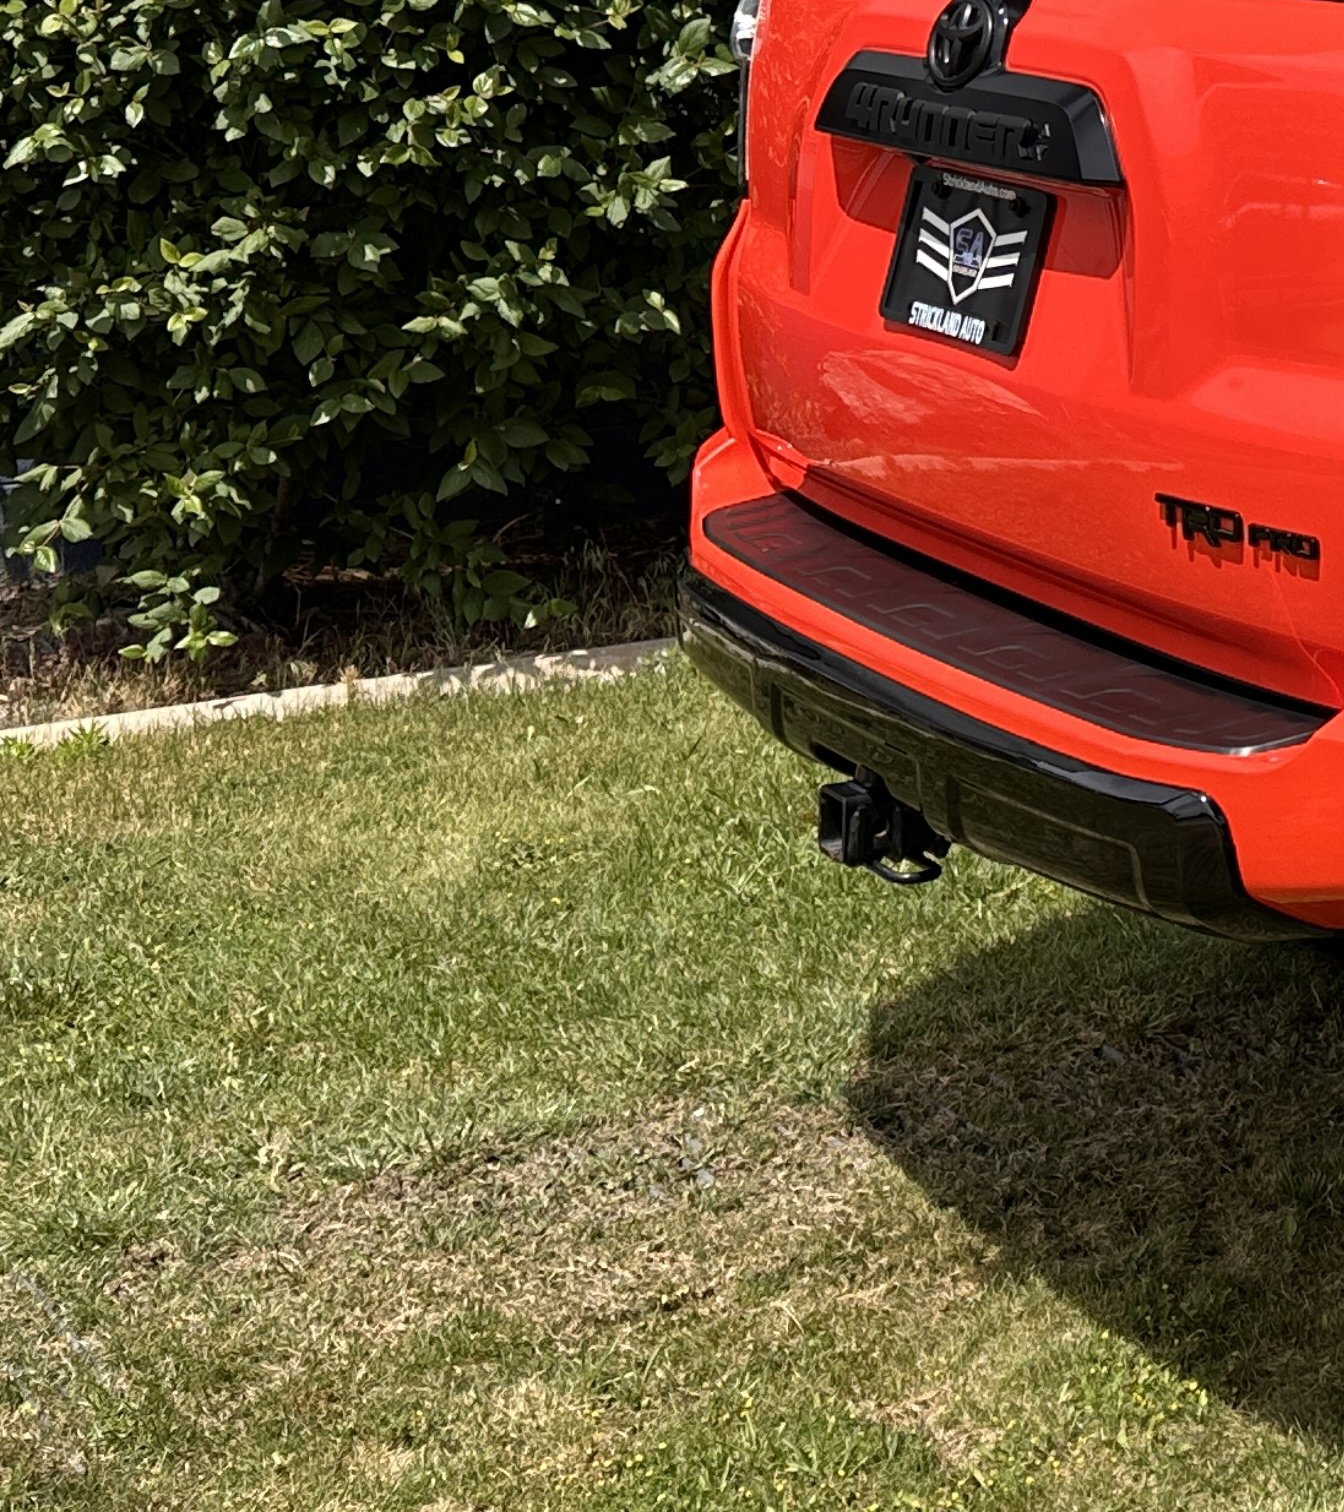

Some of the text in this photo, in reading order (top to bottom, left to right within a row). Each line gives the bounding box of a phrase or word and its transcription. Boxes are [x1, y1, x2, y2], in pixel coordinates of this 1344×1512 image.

[908, 300, 986, 345] STRICKLAND AUTO
[1154, 492, 1321, 561] TRD PRO
